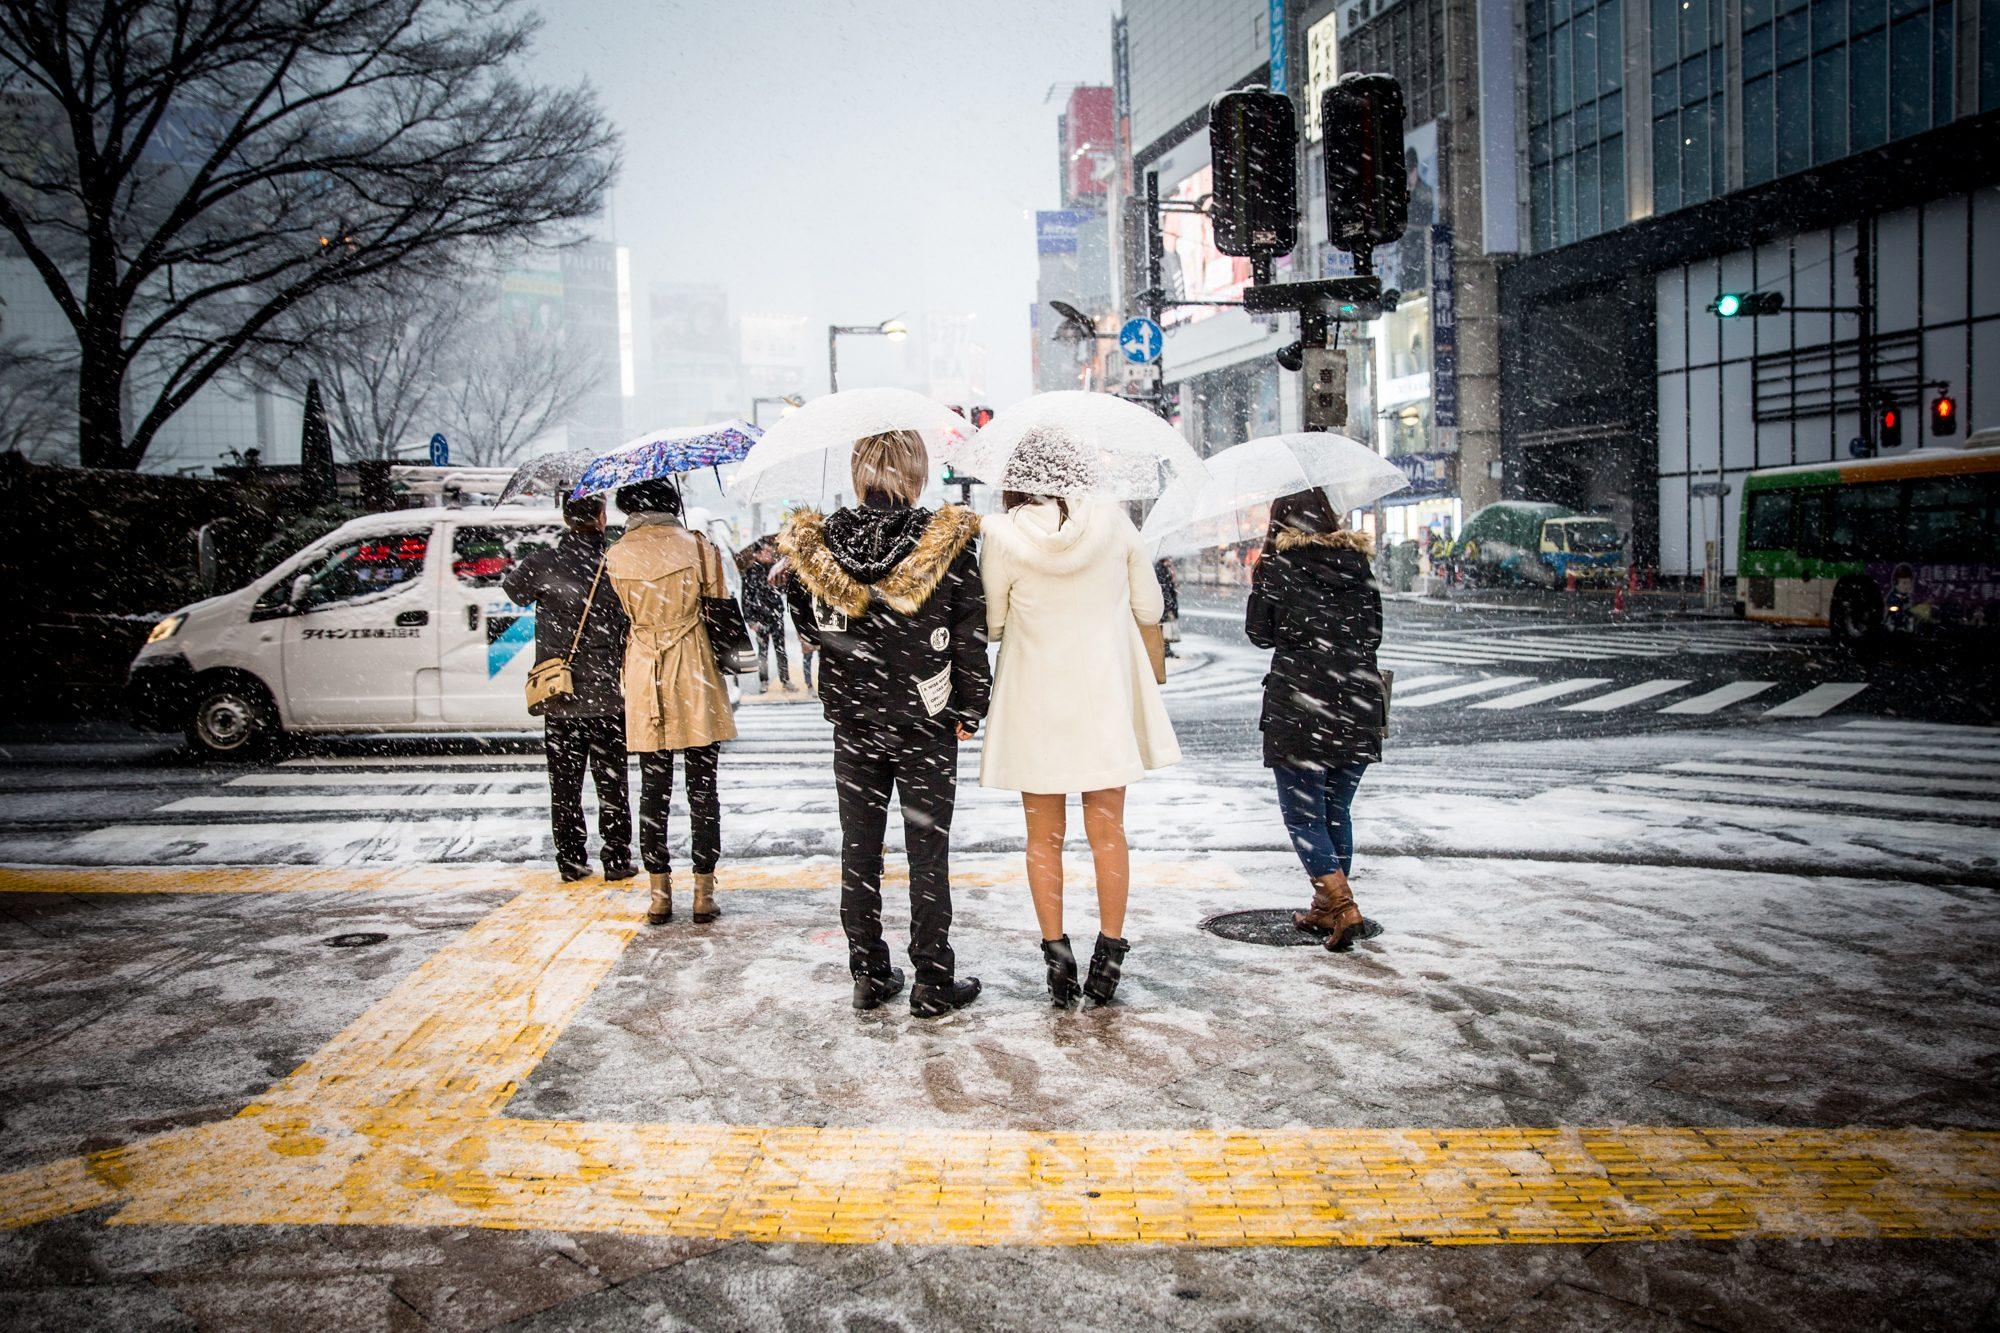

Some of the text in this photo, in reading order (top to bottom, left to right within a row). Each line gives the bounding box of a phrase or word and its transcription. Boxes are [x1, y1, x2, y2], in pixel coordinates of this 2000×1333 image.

[301, 628, 421, 640] ダイキン工業株式会社
